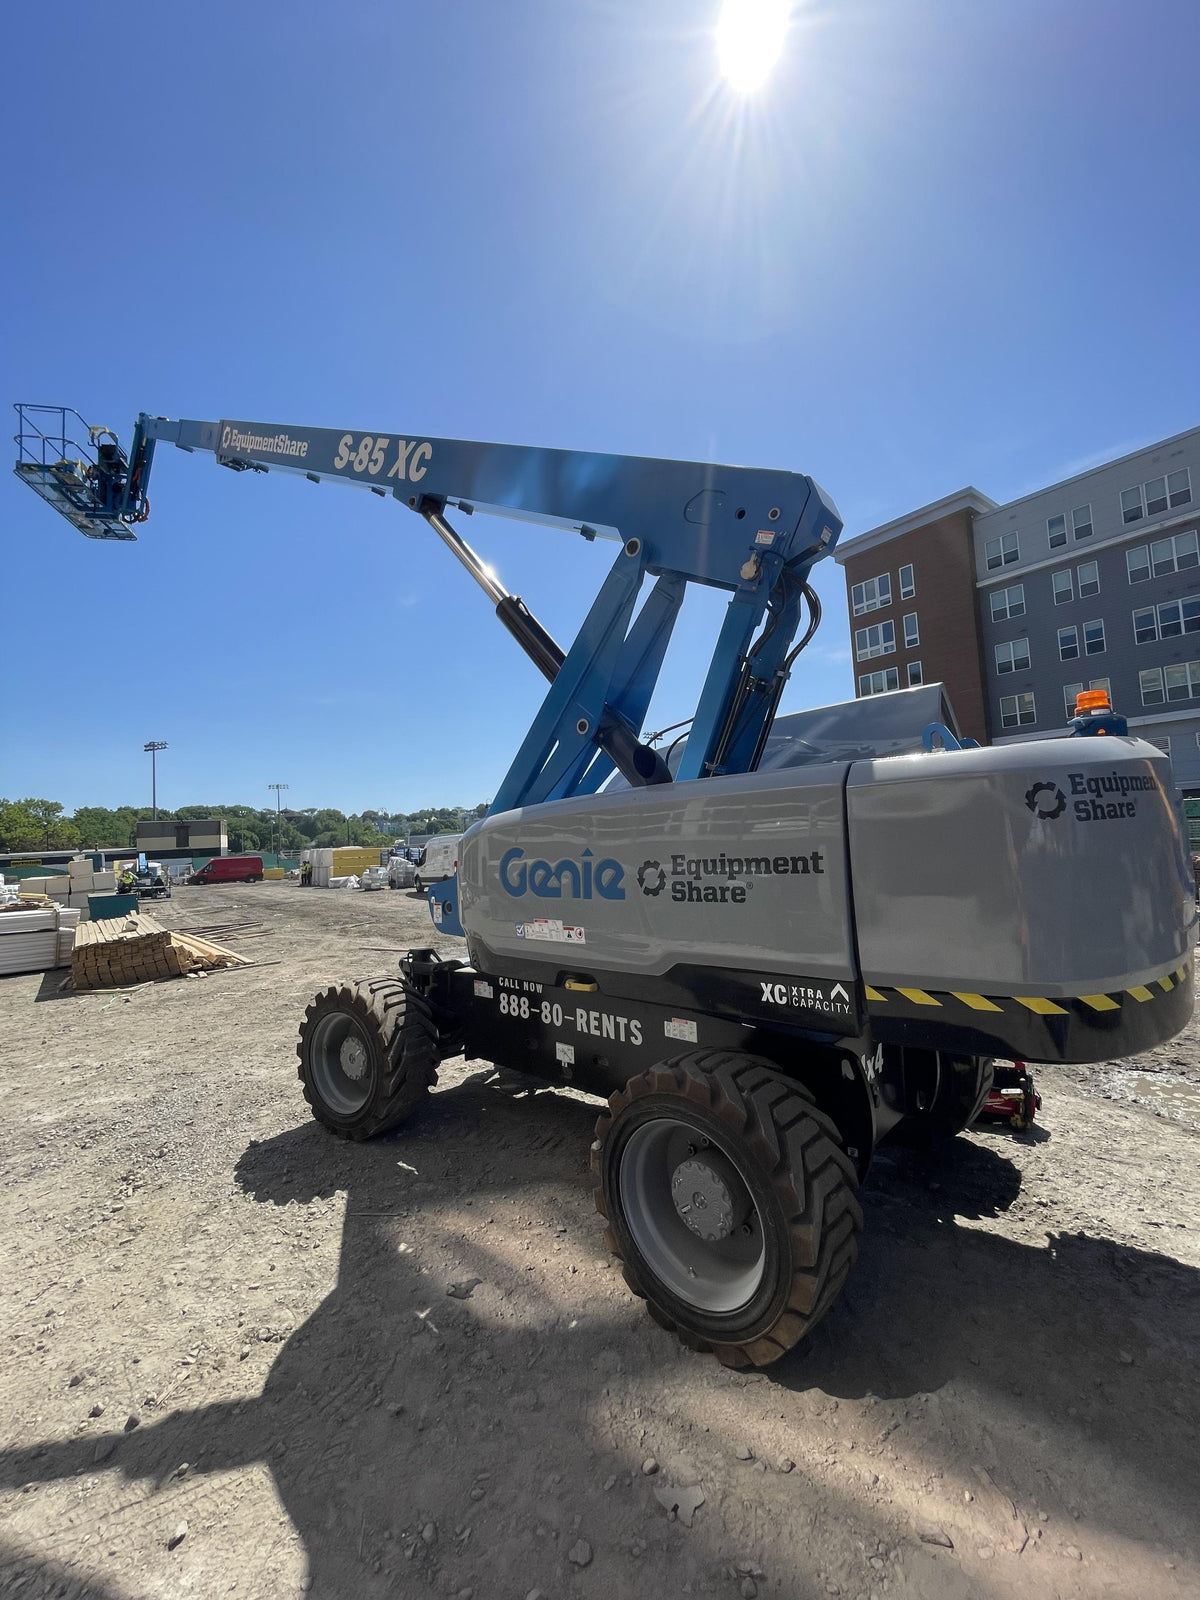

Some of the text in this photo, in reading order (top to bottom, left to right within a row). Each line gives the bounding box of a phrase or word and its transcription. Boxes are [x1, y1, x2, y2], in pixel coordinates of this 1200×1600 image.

[230, 429, 308, 457] EquipmentShare
[334, 434, 432, 482] S-85 XC
[1067, 771, 1159, 798] Equipmen
[1074, 800, 1136, 822] Share
[500, 847, 626, 900] Genie
[671, 851, 824, 879] Equipment
[671, 881, 746, 903] Share
[499, 977, 519, 989] CALL
[523, 981, 543, 994] NOW
[760, 982, 787, 1005] XC
[791, 986, 823, 1000] XTRA
[792, 997, 850, 1014] CAPACITY
[499, 993, 643, 1046] 888-80-RENTS
